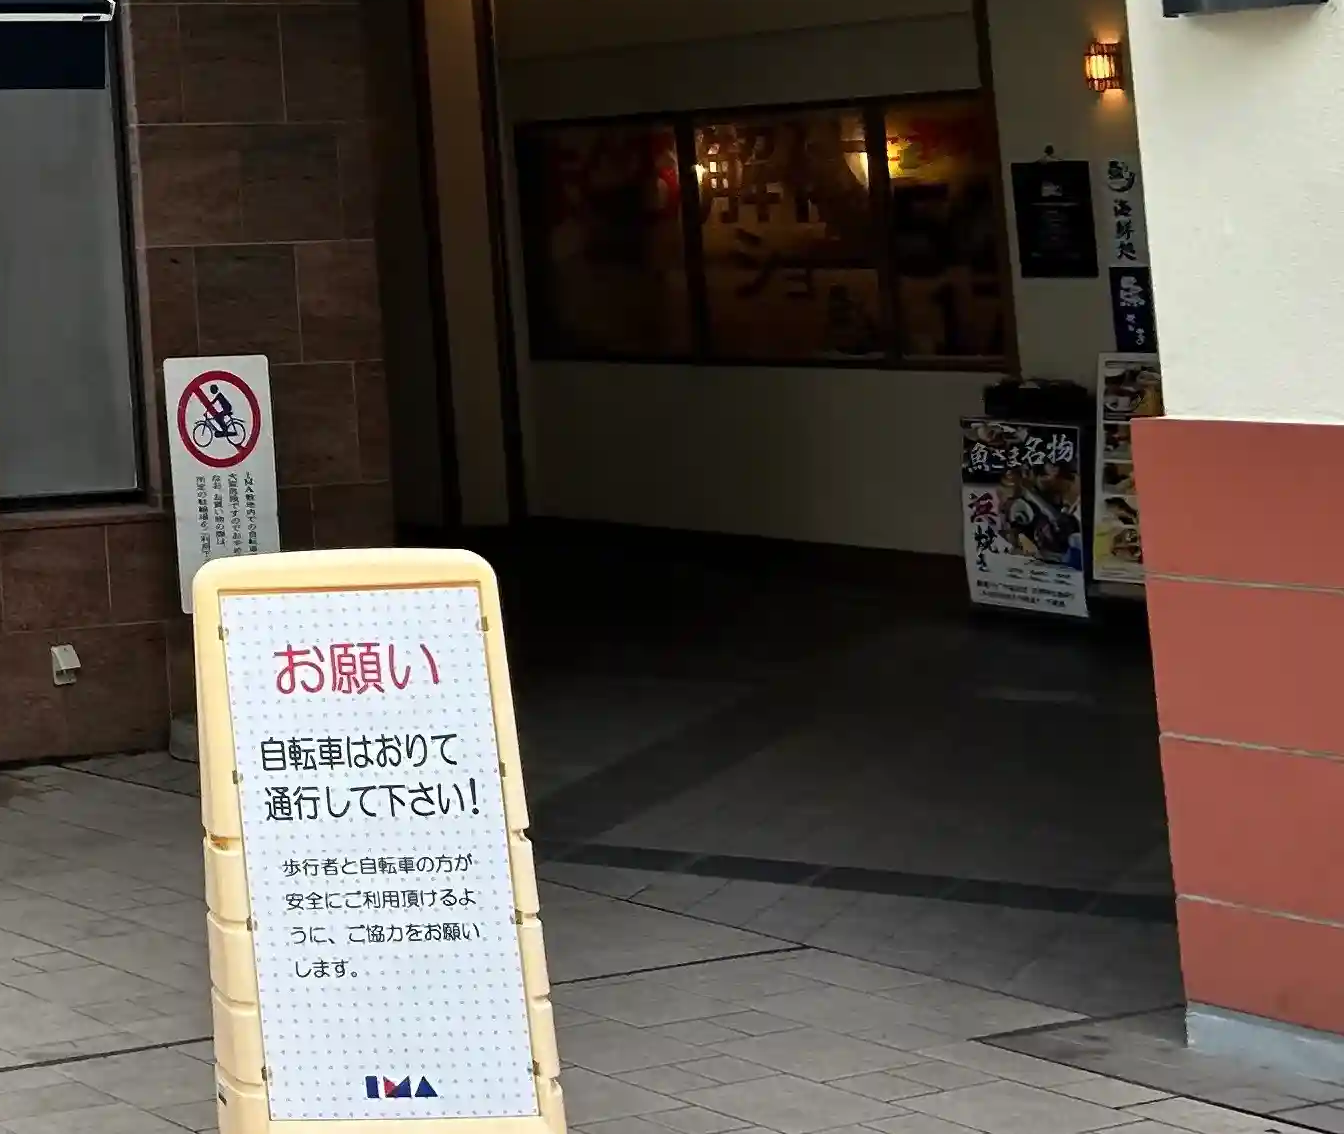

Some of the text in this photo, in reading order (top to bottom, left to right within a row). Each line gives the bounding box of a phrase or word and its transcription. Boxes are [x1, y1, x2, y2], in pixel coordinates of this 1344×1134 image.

[273, 642, 440, 694] お願い
[261, 734, 457, 771] 自転車はおりて
[282, 853, 473, 877] 歩行者と自転車の方が
[285, 888, 477, 910] 安全にご利用頂けるよ
[290, 922, 480, 944] うに、ご協力をお願い
[295, 959, 359, 978] します。
[365, 1074, 439, 1099] IMA
